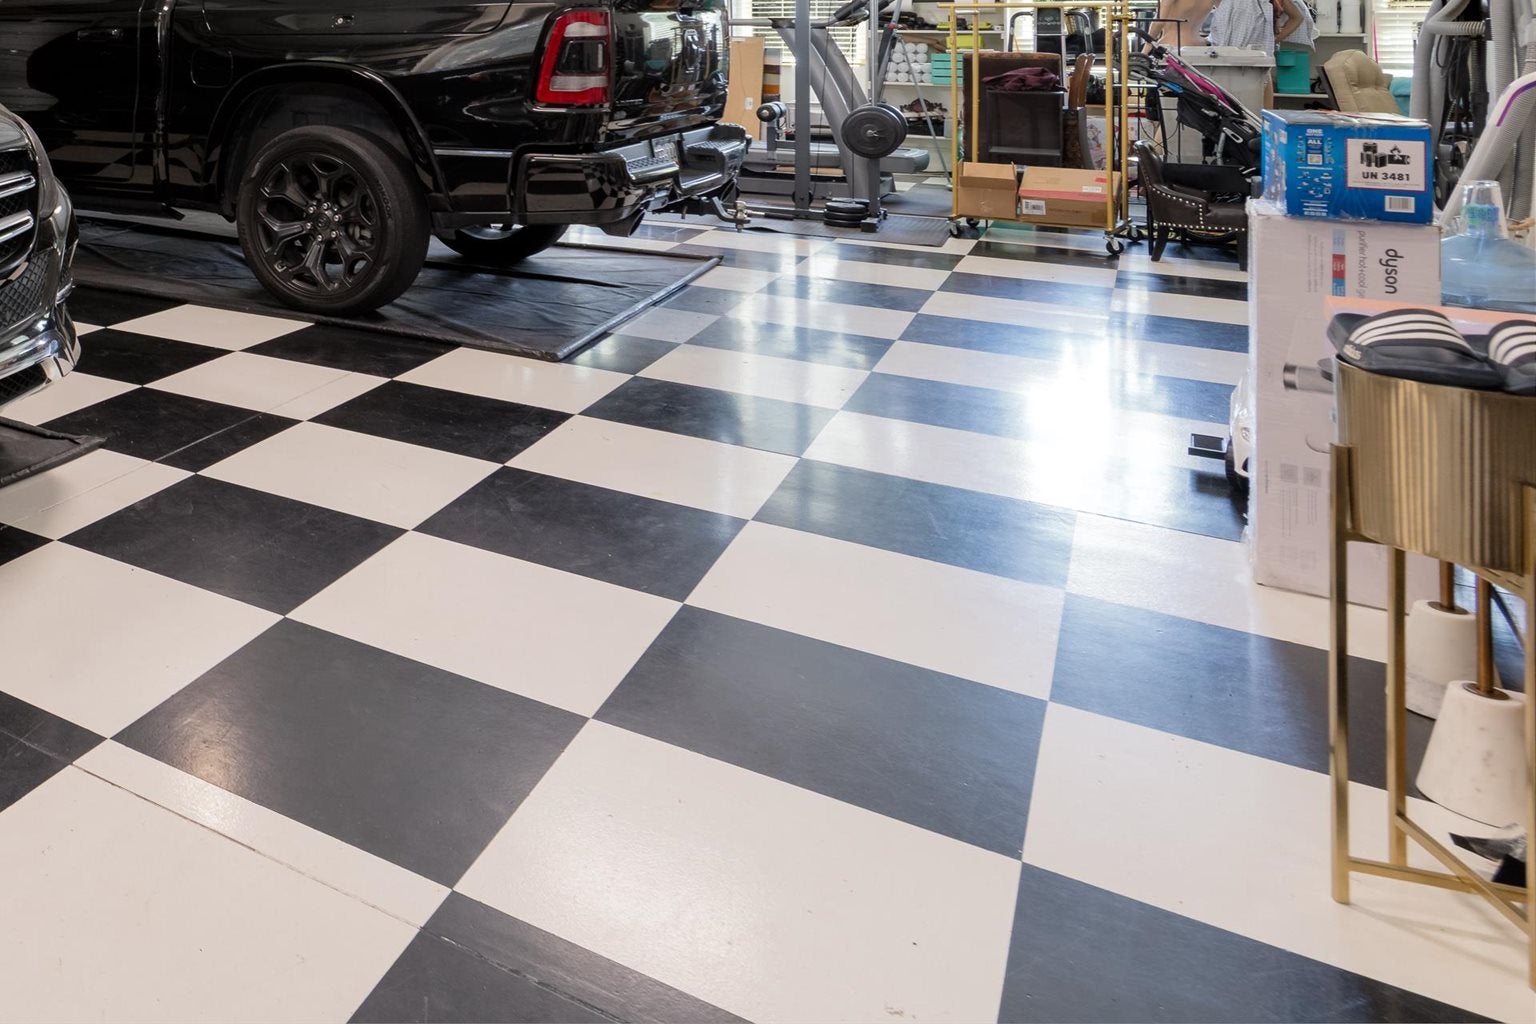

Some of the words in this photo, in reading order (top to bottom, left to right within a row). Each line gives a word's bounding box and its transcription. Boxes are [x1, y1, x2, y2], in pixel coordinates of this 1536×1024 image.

[1361, 171, 1378, 180] UN
[1381, 172, 1410, 182] 3481
[1379, 248, 1405, 294] dyson
